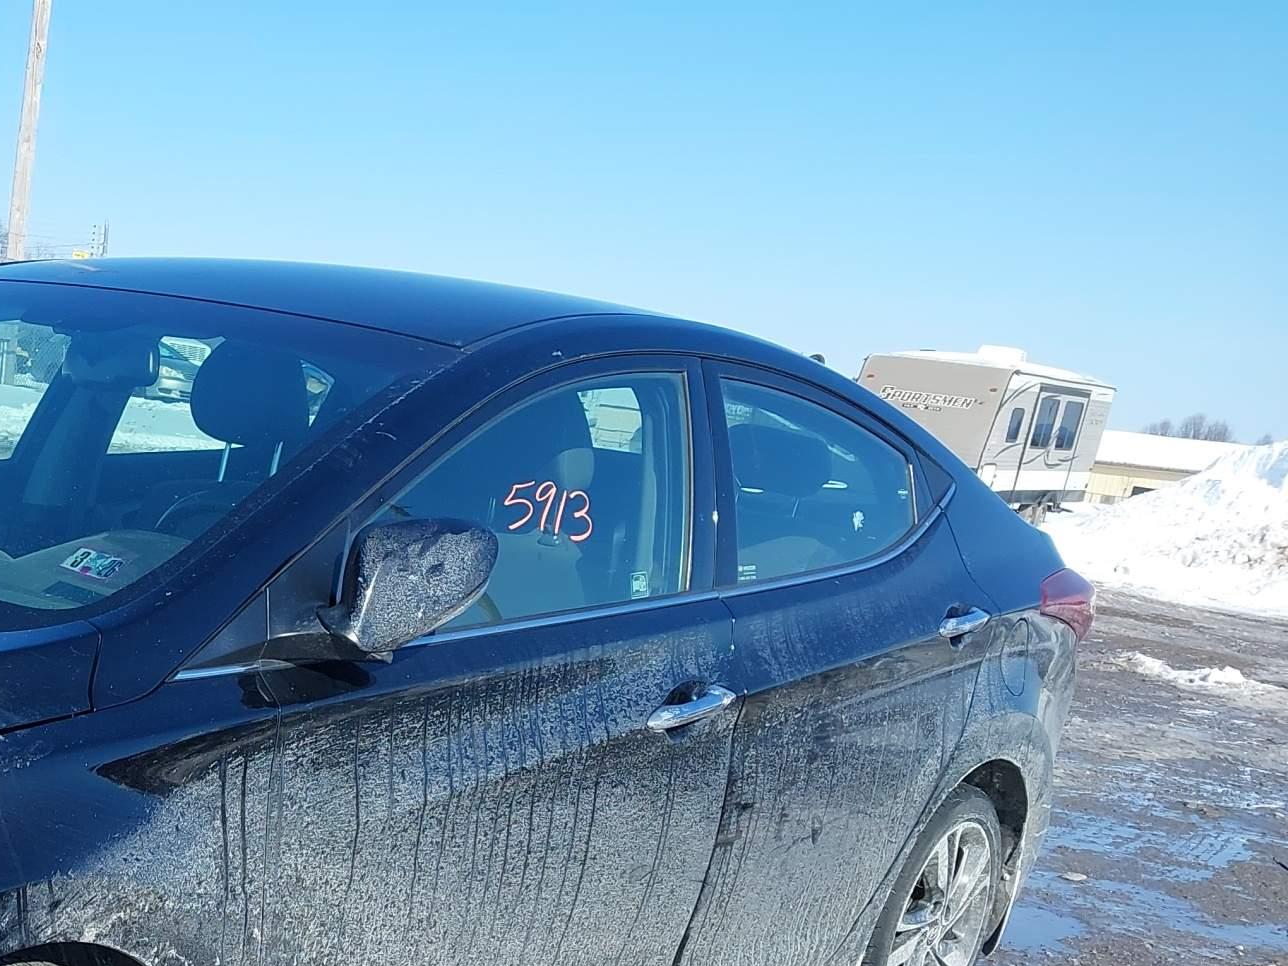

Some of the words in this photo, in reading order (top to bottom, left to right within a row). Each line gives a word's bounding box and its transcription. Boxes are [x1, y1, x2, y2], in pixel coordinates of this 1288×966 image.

[880, 385, 975, 409] SPORTSMEN
[503, 481, 593, 543] 5913
[70, 551, 92, 568] 3
